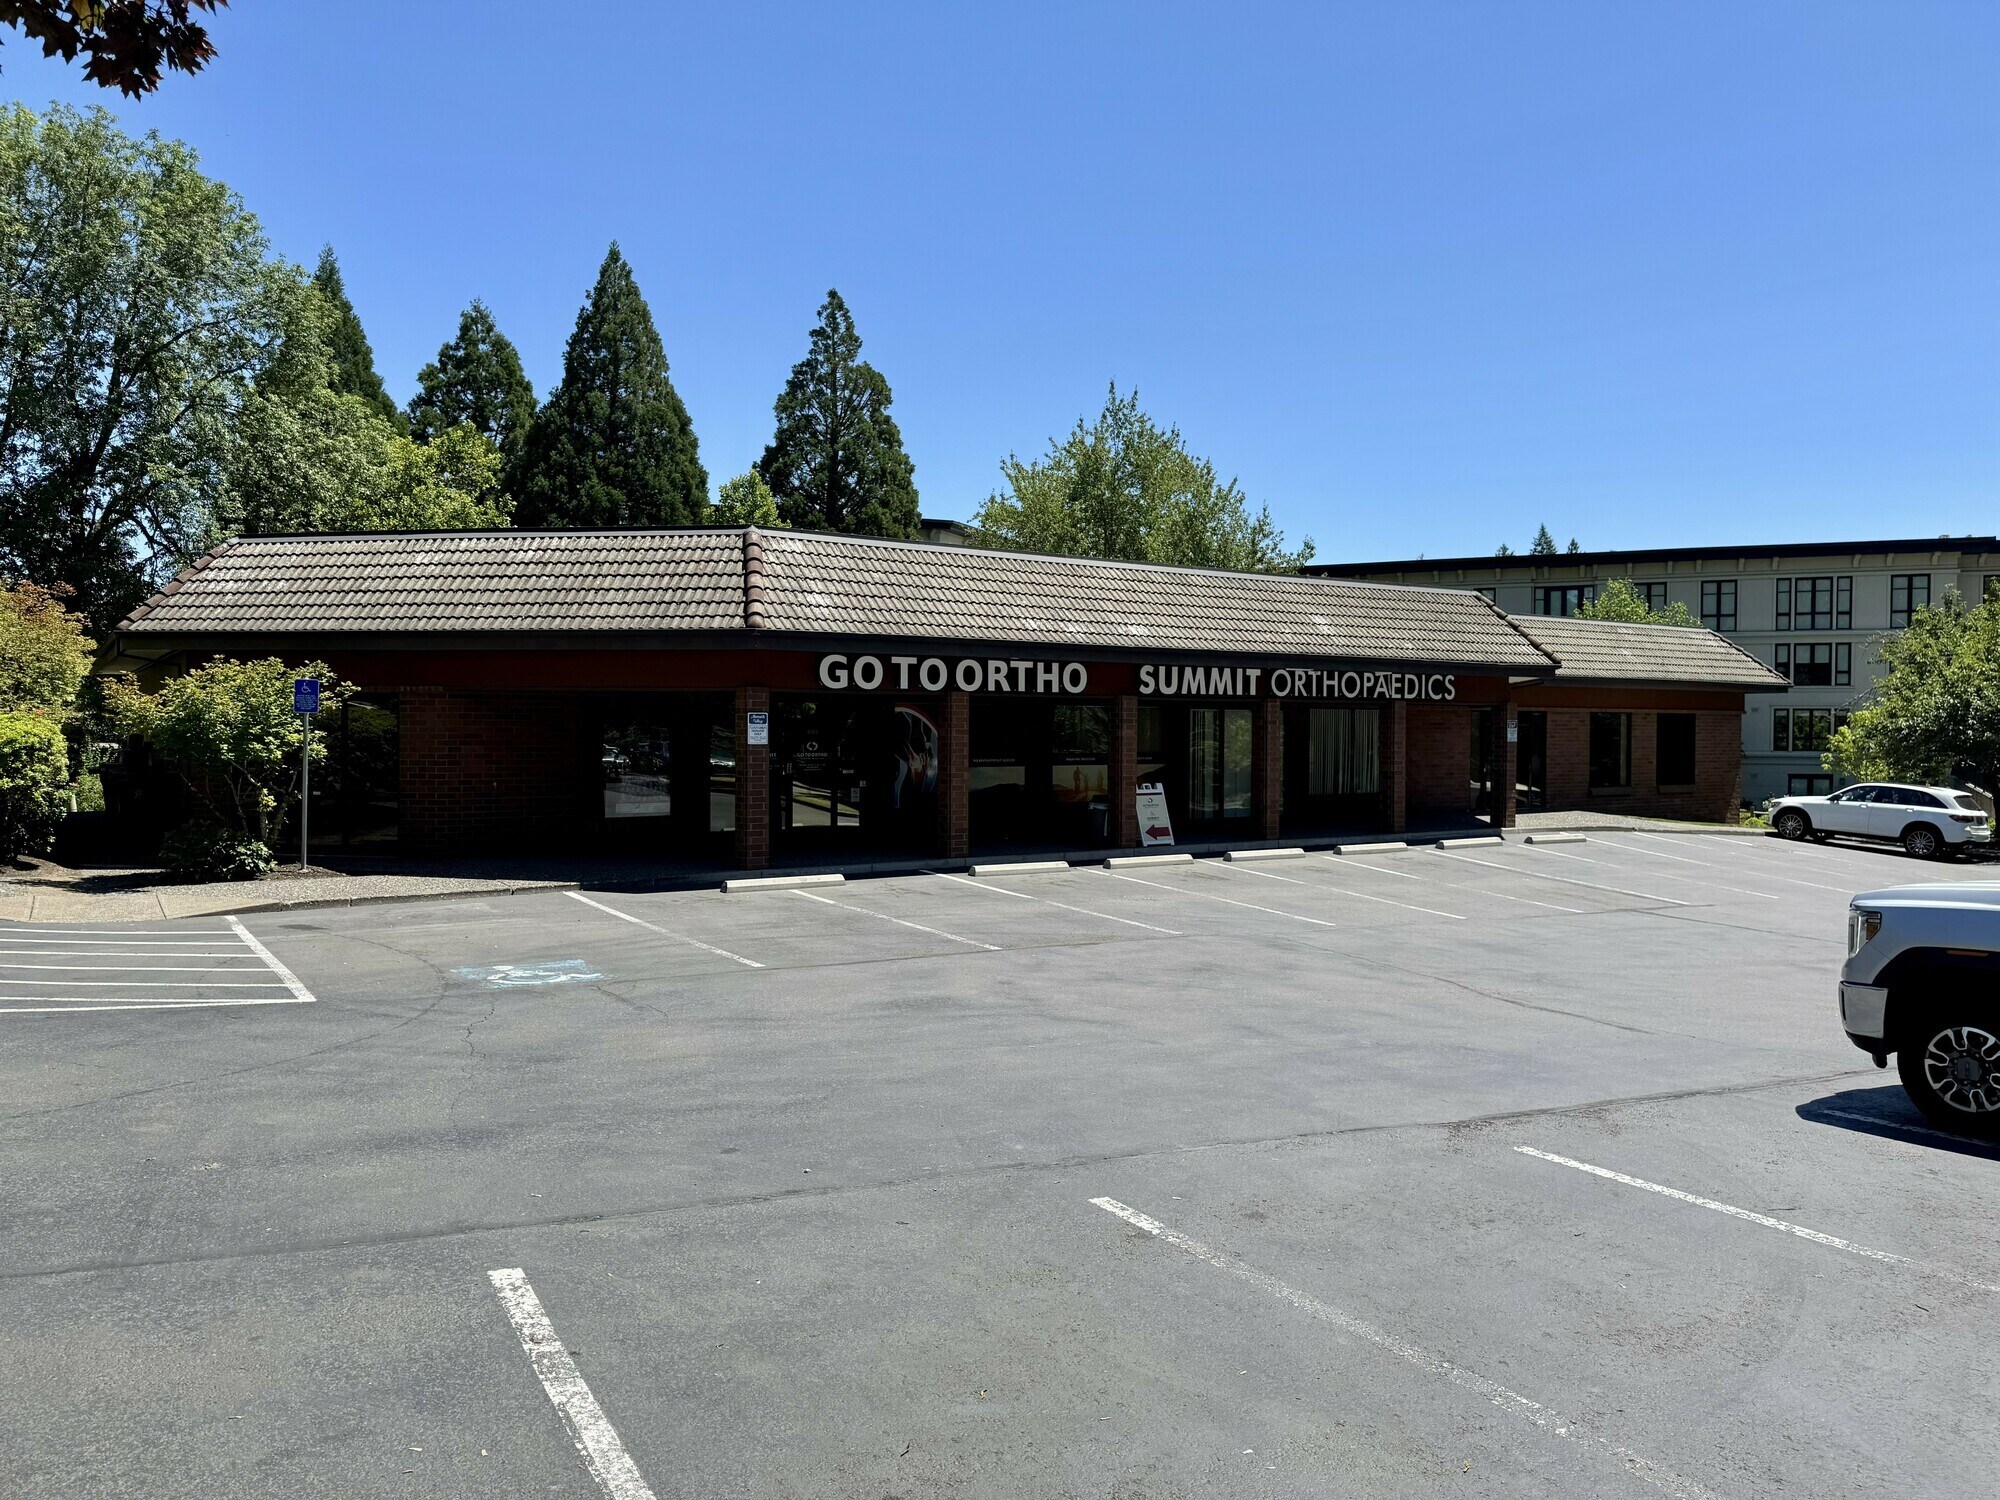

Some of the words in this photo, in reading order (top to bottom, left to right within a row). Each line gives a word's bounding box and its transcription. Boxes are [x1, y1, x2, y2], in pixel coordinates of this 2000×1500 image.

[819, 654, 884, 690] GO
[891, 656, 948, 691] TO
[955, 659, 1088, 694] ORTHO
[1139, 664, 1261, 696] SUMMIT
[1271, 669, 1456, 700] ORTHOPAEDICS
